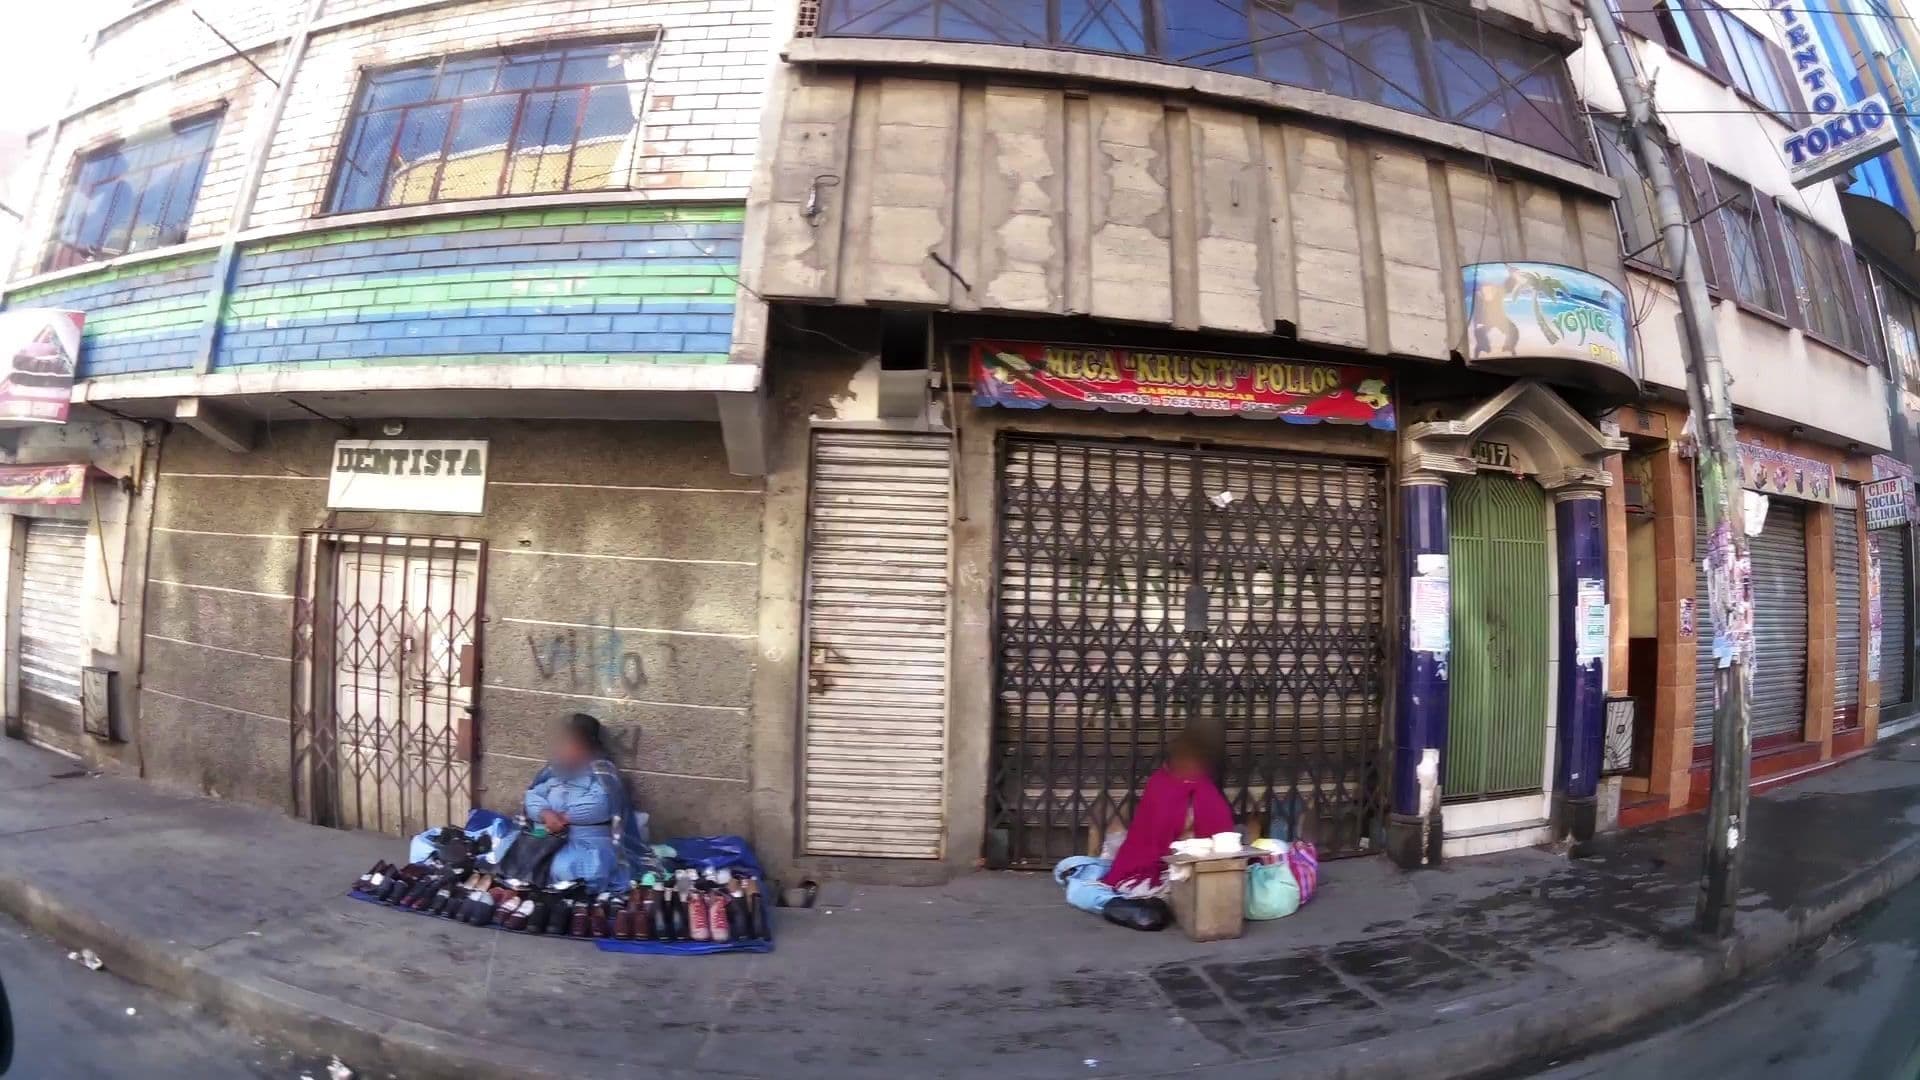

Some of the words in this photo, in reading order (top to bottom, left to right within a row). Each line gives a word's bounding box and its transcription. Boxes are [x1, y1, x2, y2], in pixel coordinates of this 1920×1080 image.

[1769, 0, 1837, 115] IENTO
[1784, 101, 1885, 166] TOKIO
[1045, 348, 1121, 382] MEGA
[337, 447, 482, 476] DENTISTA
[1865, 494, 1904, 509] SOCIAL
[1868, 481, 1897, 496] CLUB
